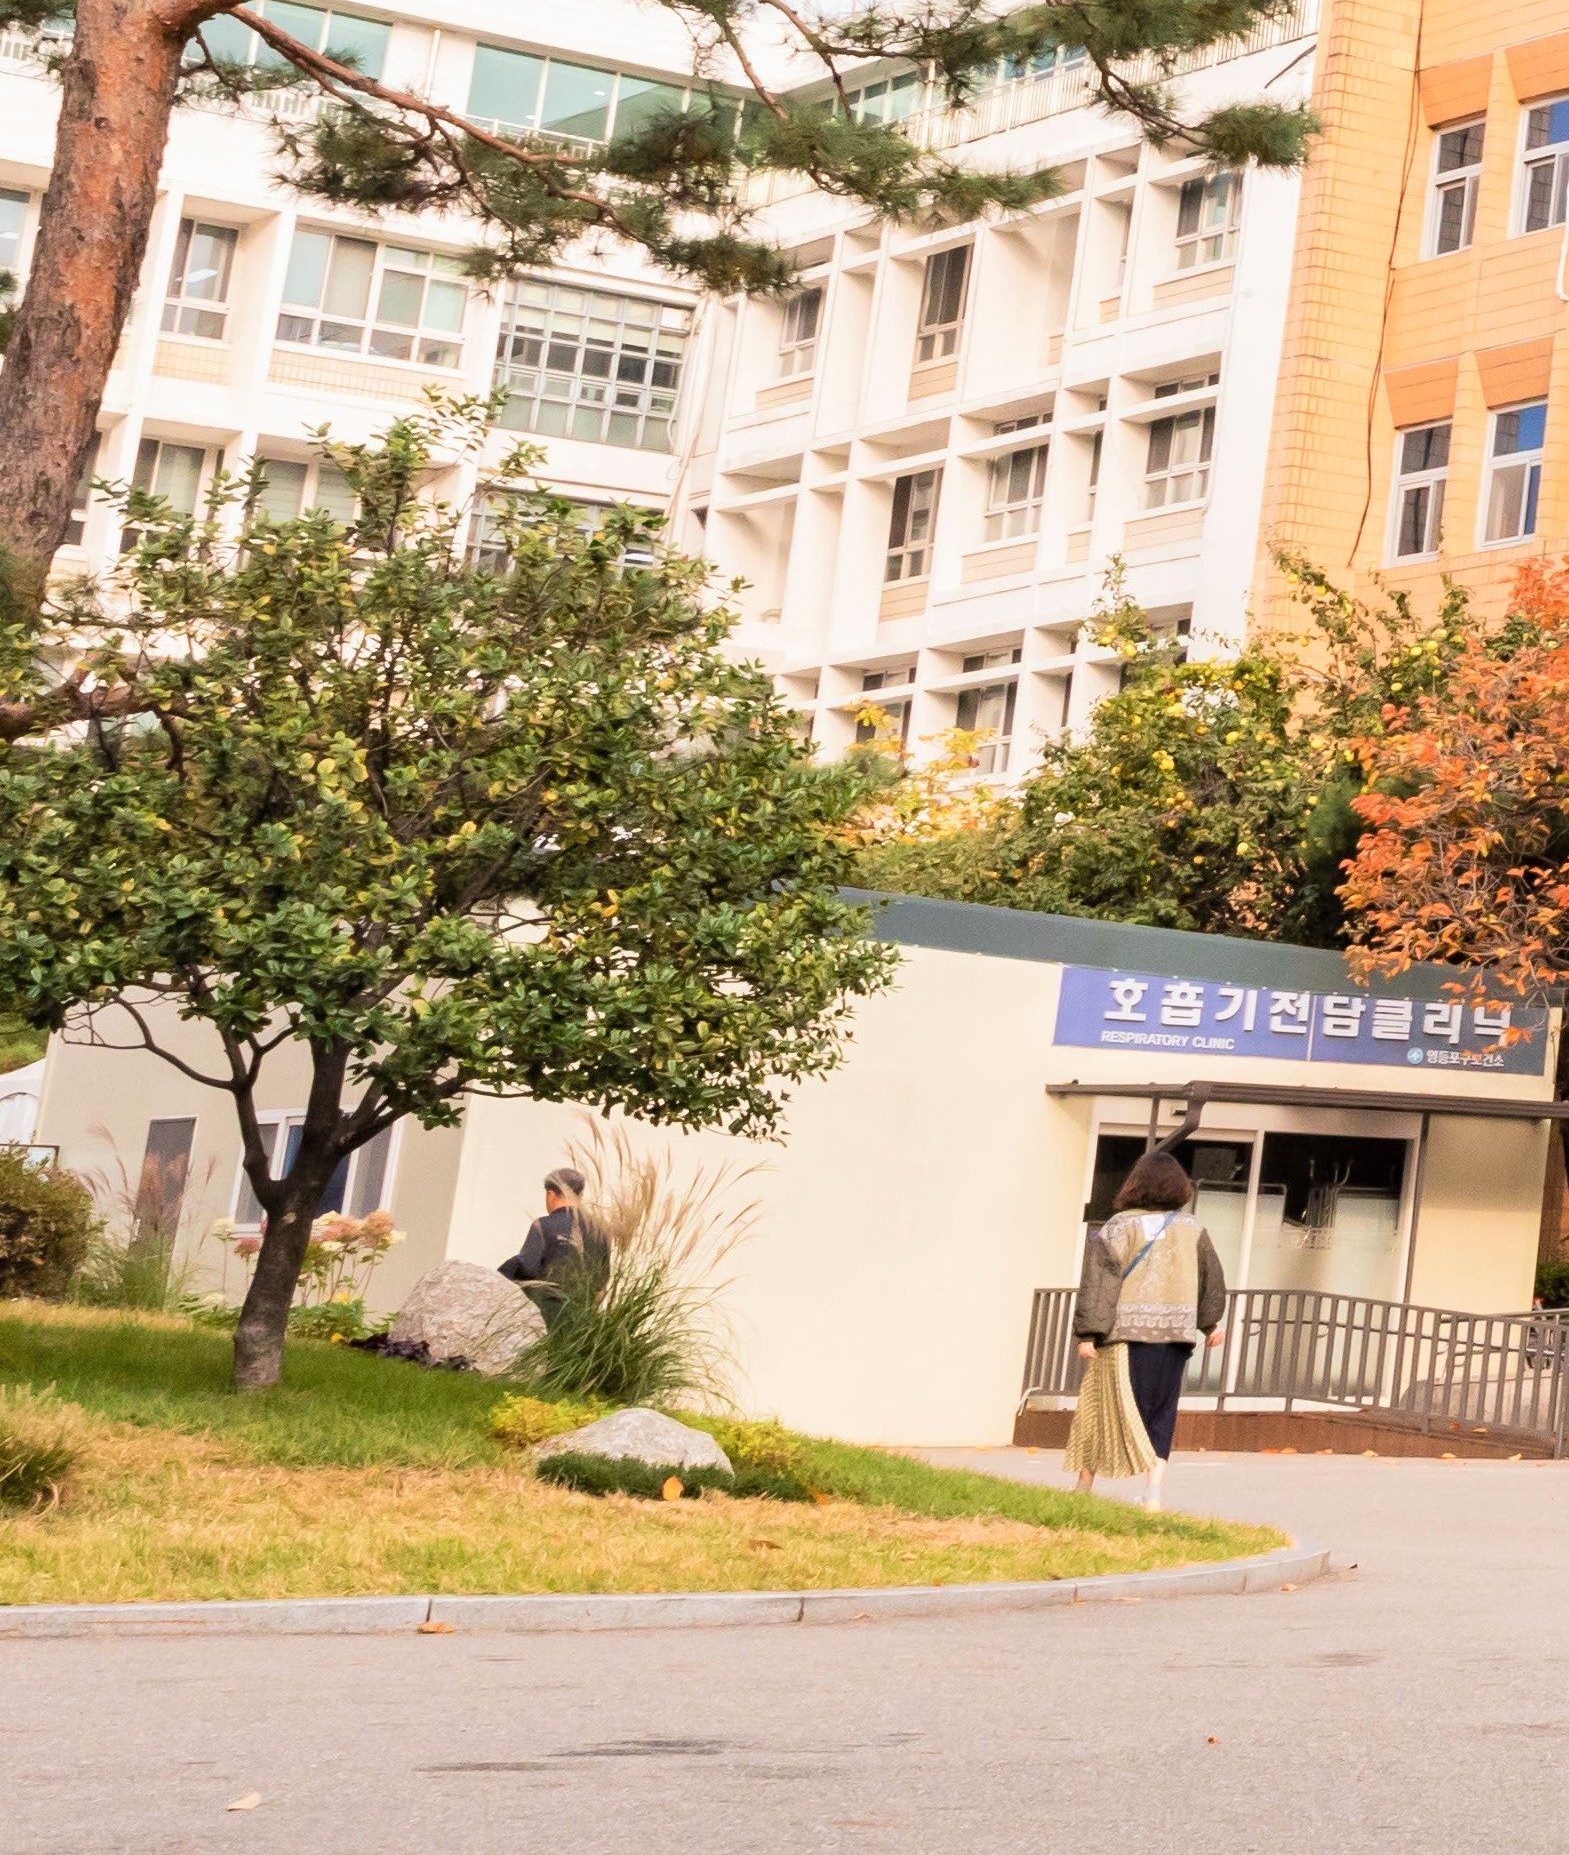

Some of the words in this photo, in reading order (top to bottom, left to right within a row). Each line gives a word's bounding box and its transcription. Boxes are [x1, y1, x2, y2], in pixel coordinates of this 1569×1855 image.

[1104, 978, 1512, 1046] 호흡기전담클리닉
[1101, 1030, 1189, 1047] RESPIRATORY
[1192, 1036, 1235, 1049] CLINIC
